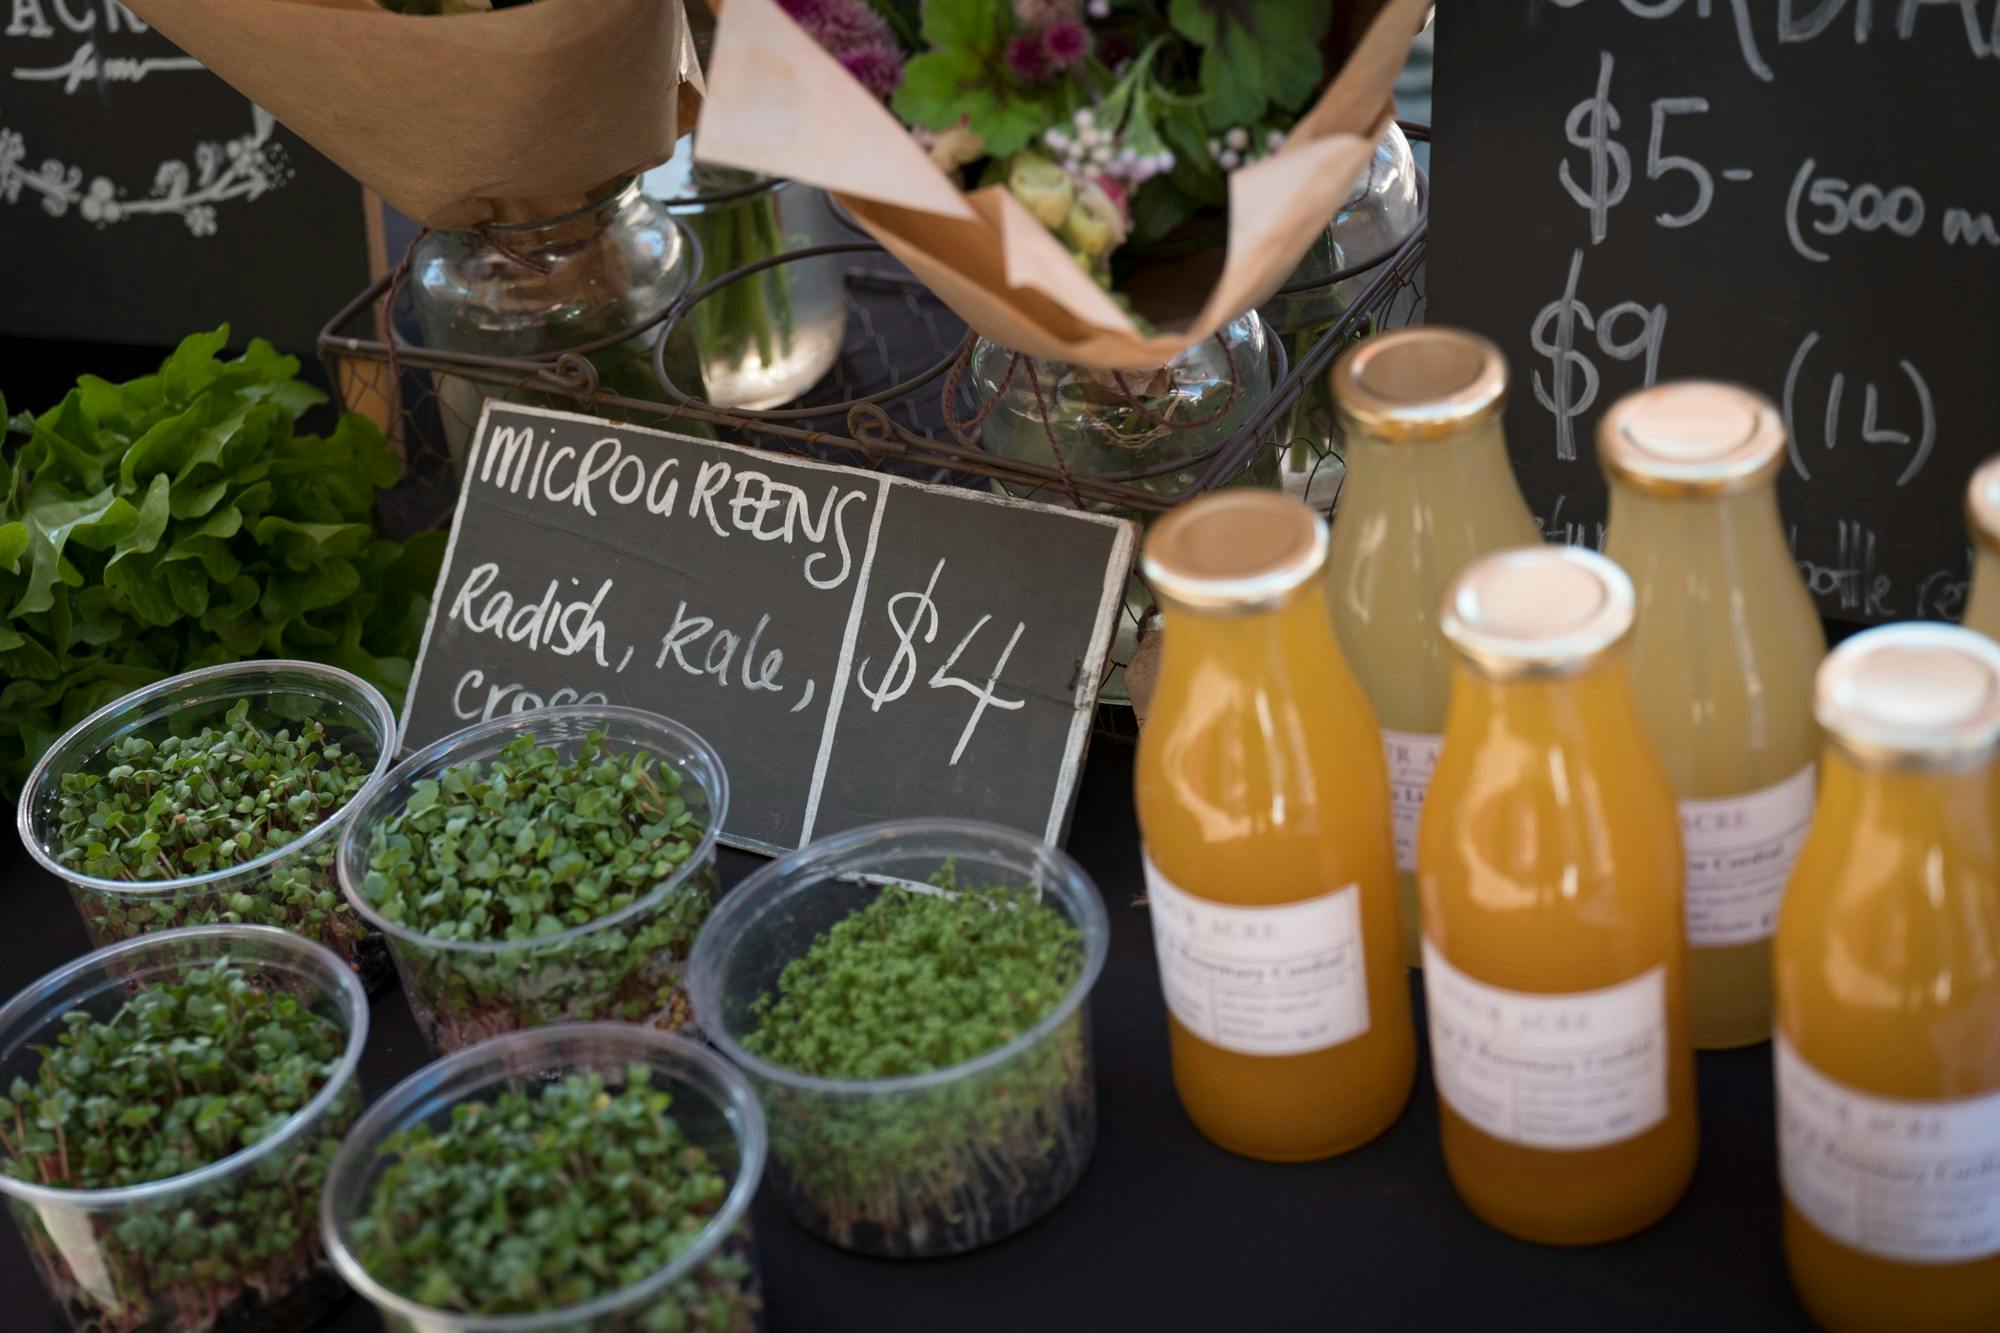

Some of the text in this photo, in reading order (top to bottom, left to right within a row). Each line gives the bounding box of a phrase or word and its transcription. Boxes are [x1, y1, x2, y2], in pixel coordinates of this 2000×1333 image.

[1786, 158, 1925, 262] (500
[1530, 248, 1667, 460] $9
[449, 562, 634, 673] Radish,
[857, 558, 1025, 766] $4
